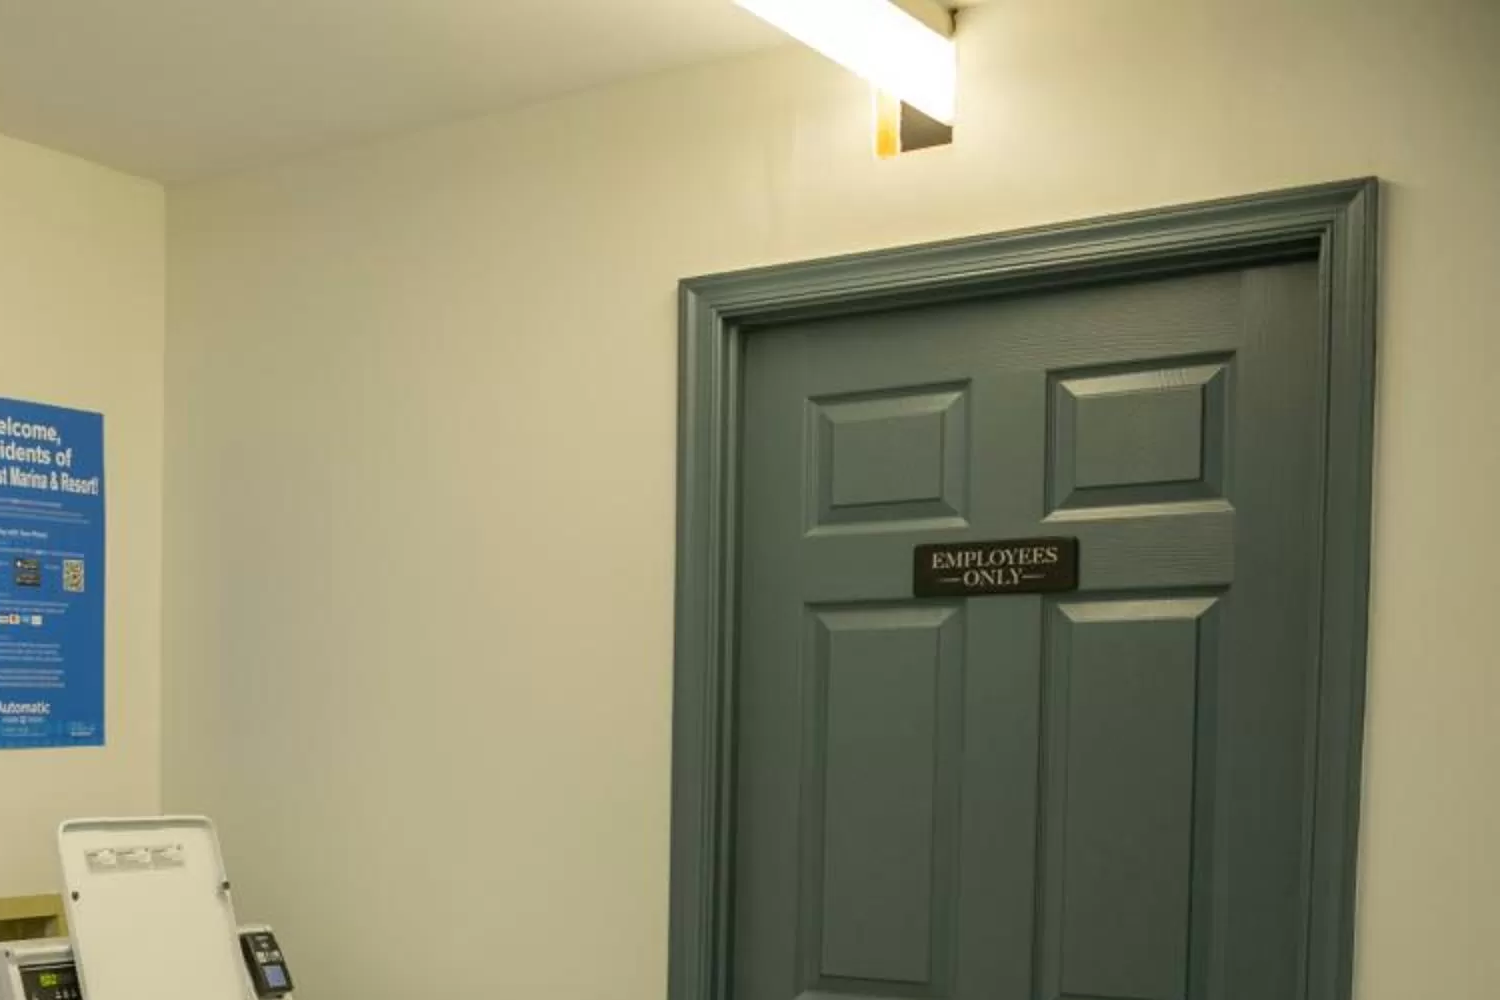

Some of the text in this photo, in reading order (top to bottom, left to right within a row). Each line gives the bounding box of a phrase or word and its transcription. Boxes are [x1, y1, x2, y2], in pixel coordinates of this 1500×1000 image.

[55, 448, 72, 467] of
[10, 466, 47, 490] Marina
[50, 472, 59, 490] &
[61, 472, 99, 496] Resort!
[931, 547, 1058, 569] EMPLOYEES
[963, 568, 1022, 586] ONLY
